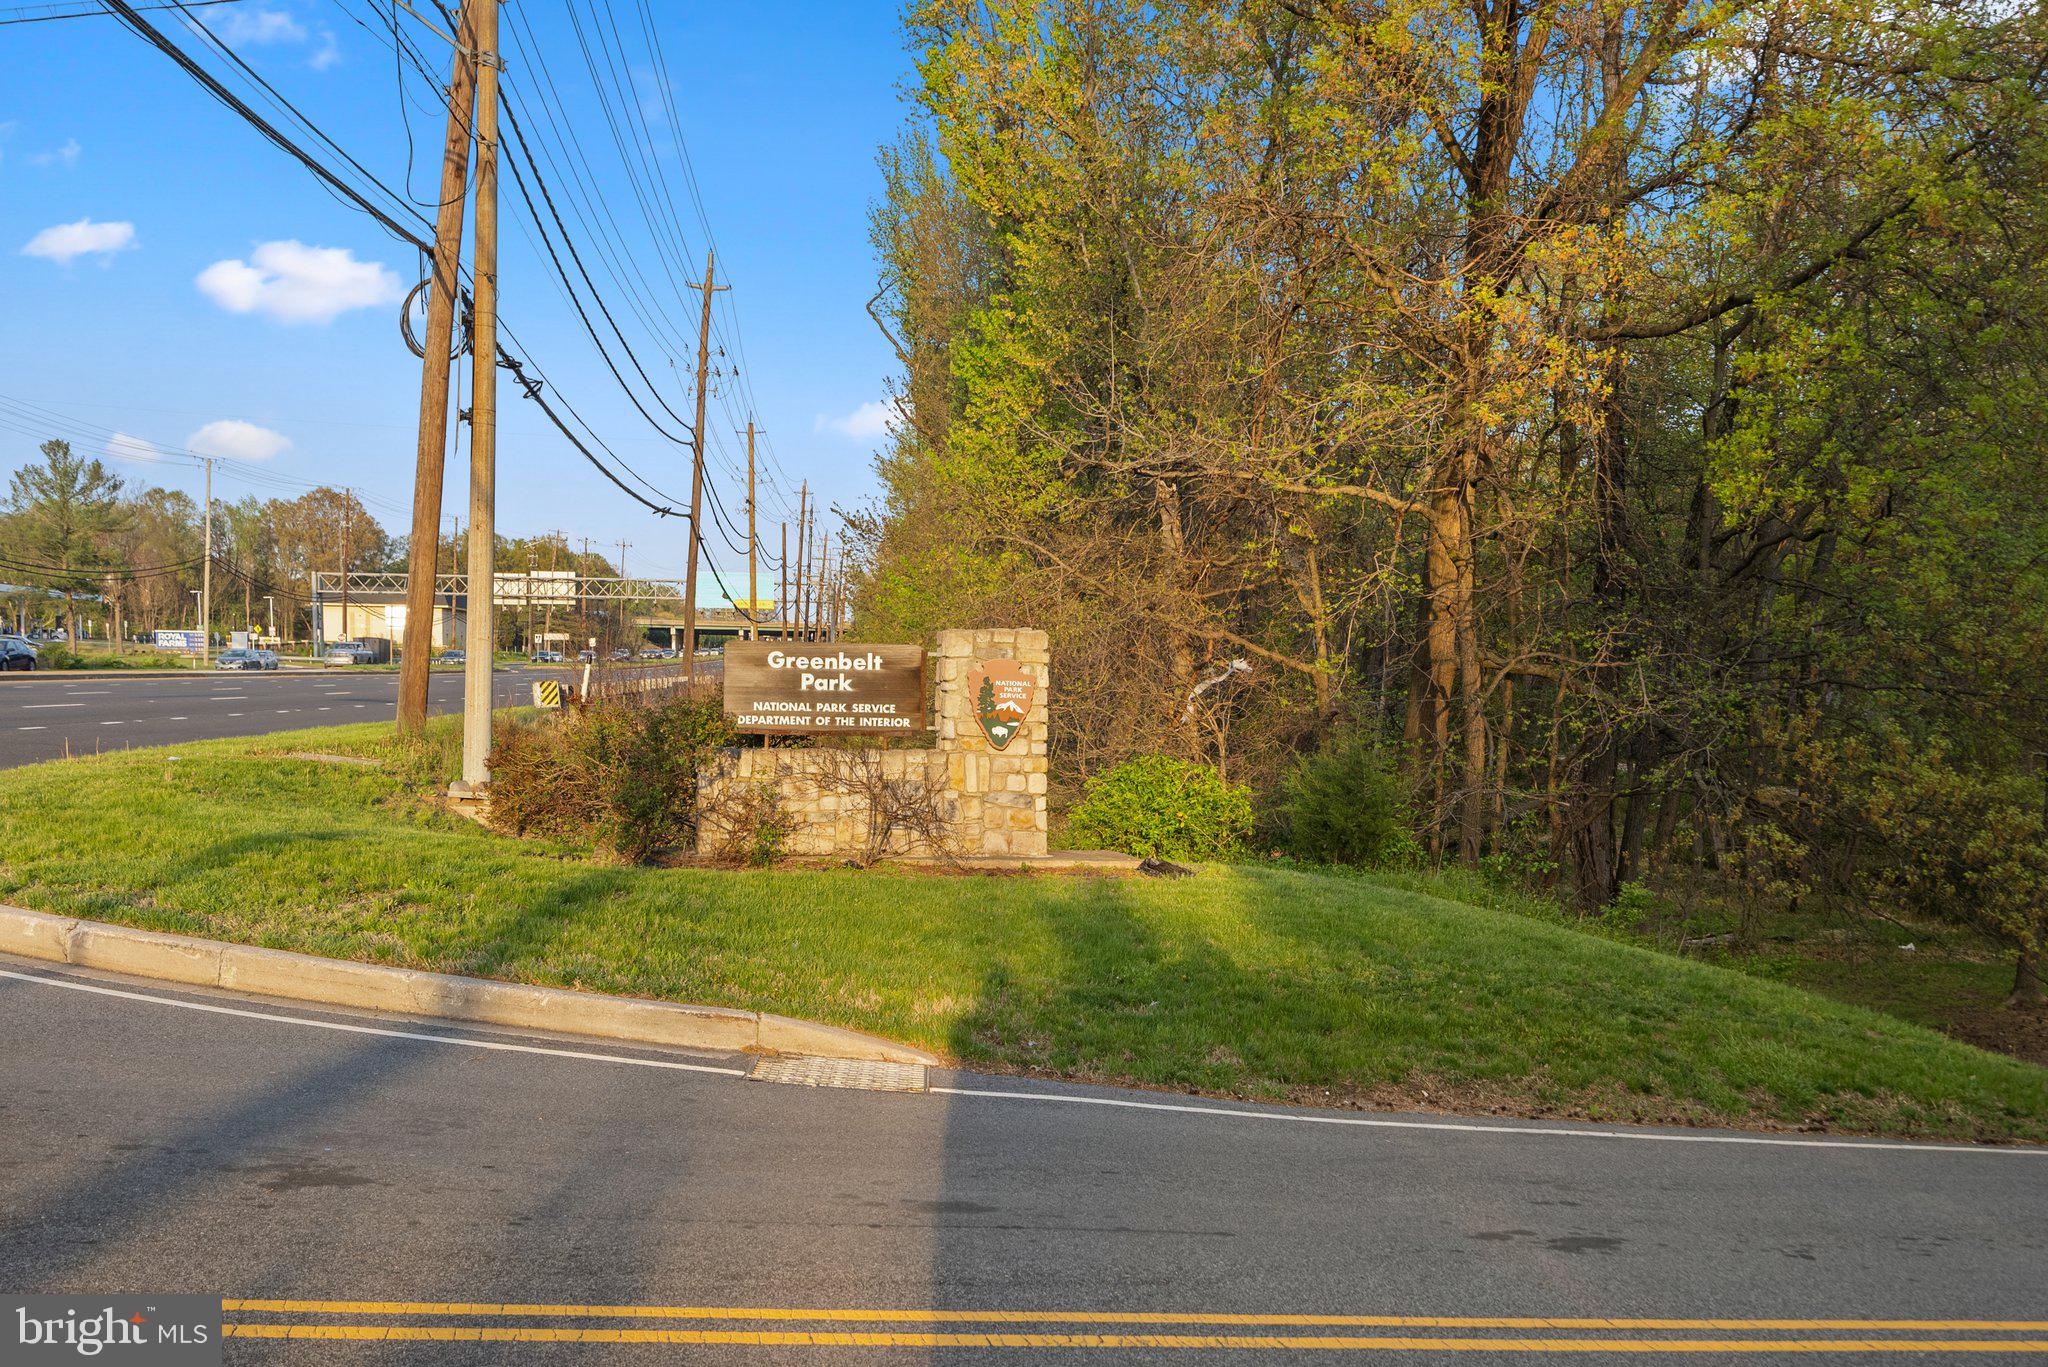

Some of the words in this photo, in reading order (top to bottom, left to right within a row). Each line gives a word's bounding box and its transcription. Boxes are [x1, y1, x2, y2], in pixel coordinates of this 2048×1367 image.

[158, 632, 186, 640] ROYAL
[767, 651, 883, 671] Greenbelt
[801, 673, 853, 691] Park
[753, 702, 812, 712] NATIONAL
[816, 703, 847, 713] PARK
[852, 703, 896, 714] SERVICE
[737, 715, 811, 726] DEPARTMENT
[815, 716, 831, 726] OF
[835, 716, 855, 727] THE
[859, 717, 911, 728] INTERIOR
